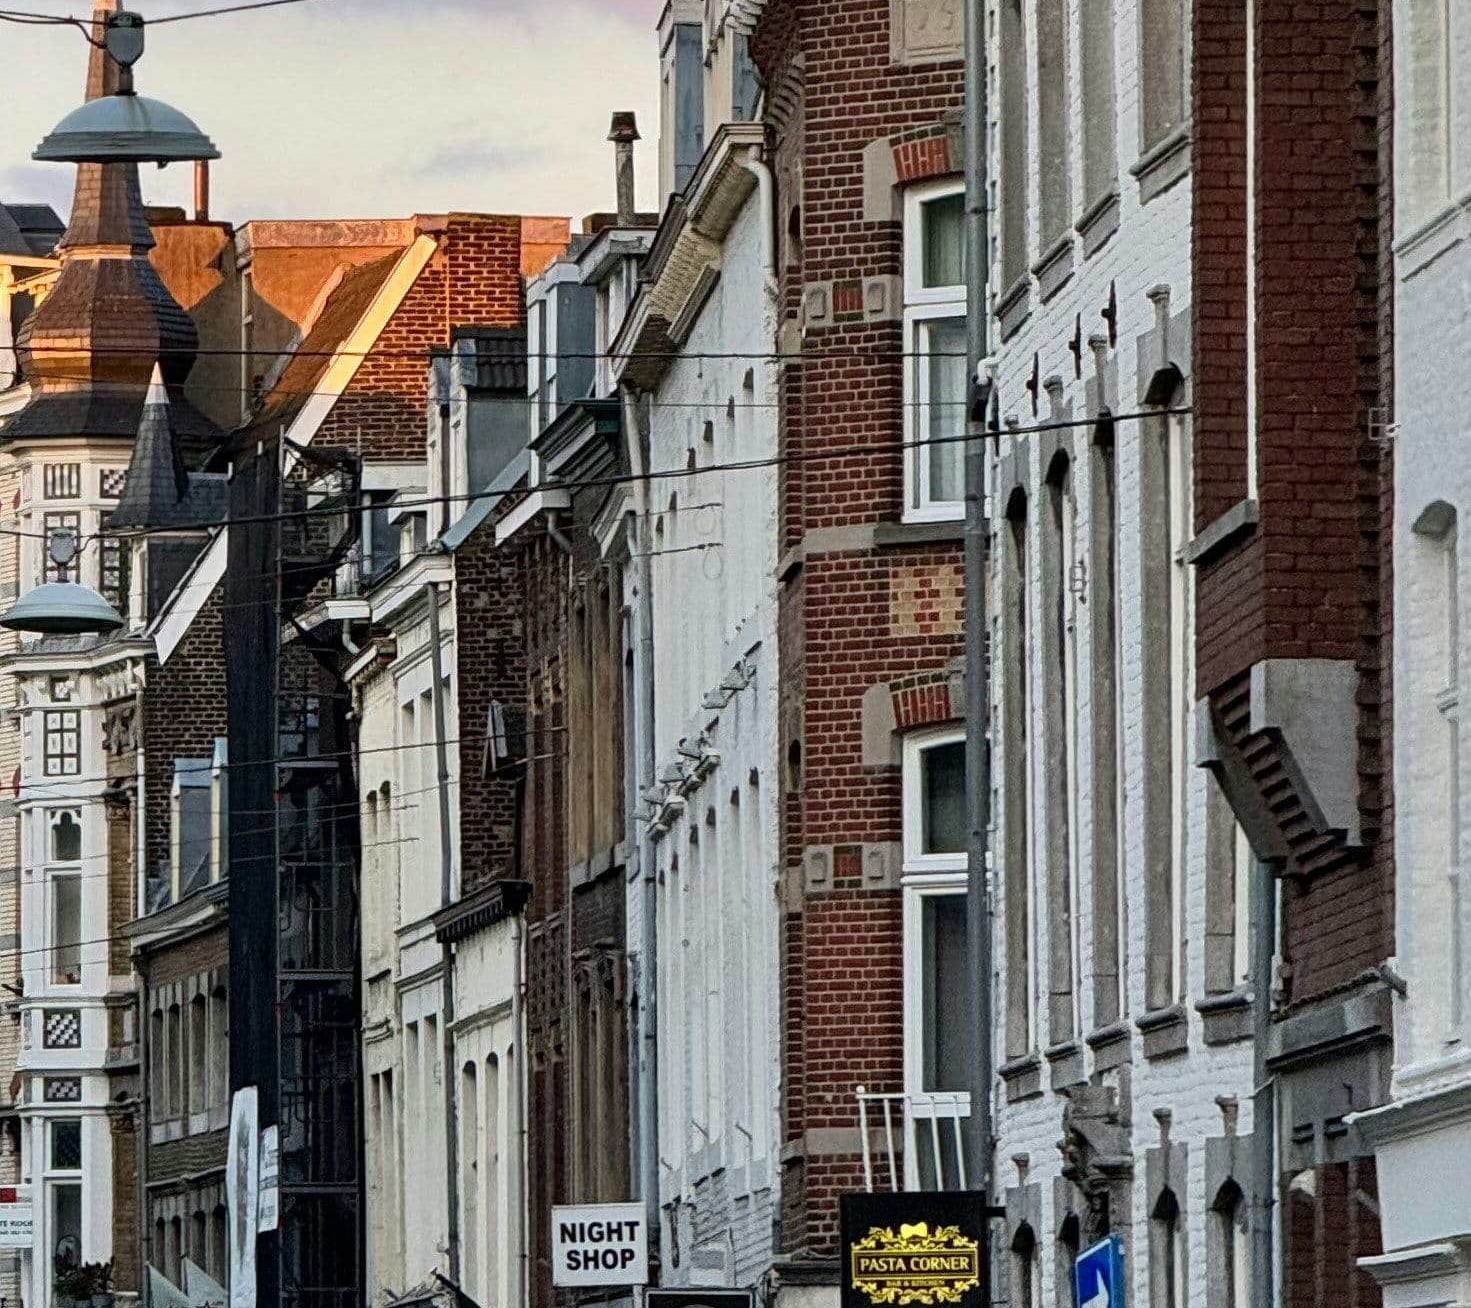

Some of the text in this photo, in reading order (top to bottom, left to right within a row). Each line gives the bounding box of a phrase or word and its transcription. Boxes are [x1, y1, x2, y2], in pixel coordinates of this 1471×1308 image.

[560, 1221, 640, 1243] NIGHT
[566, 1249, 635, 1271] SHOP
[860, 1256, 970, 1272] PASTA CORNER
